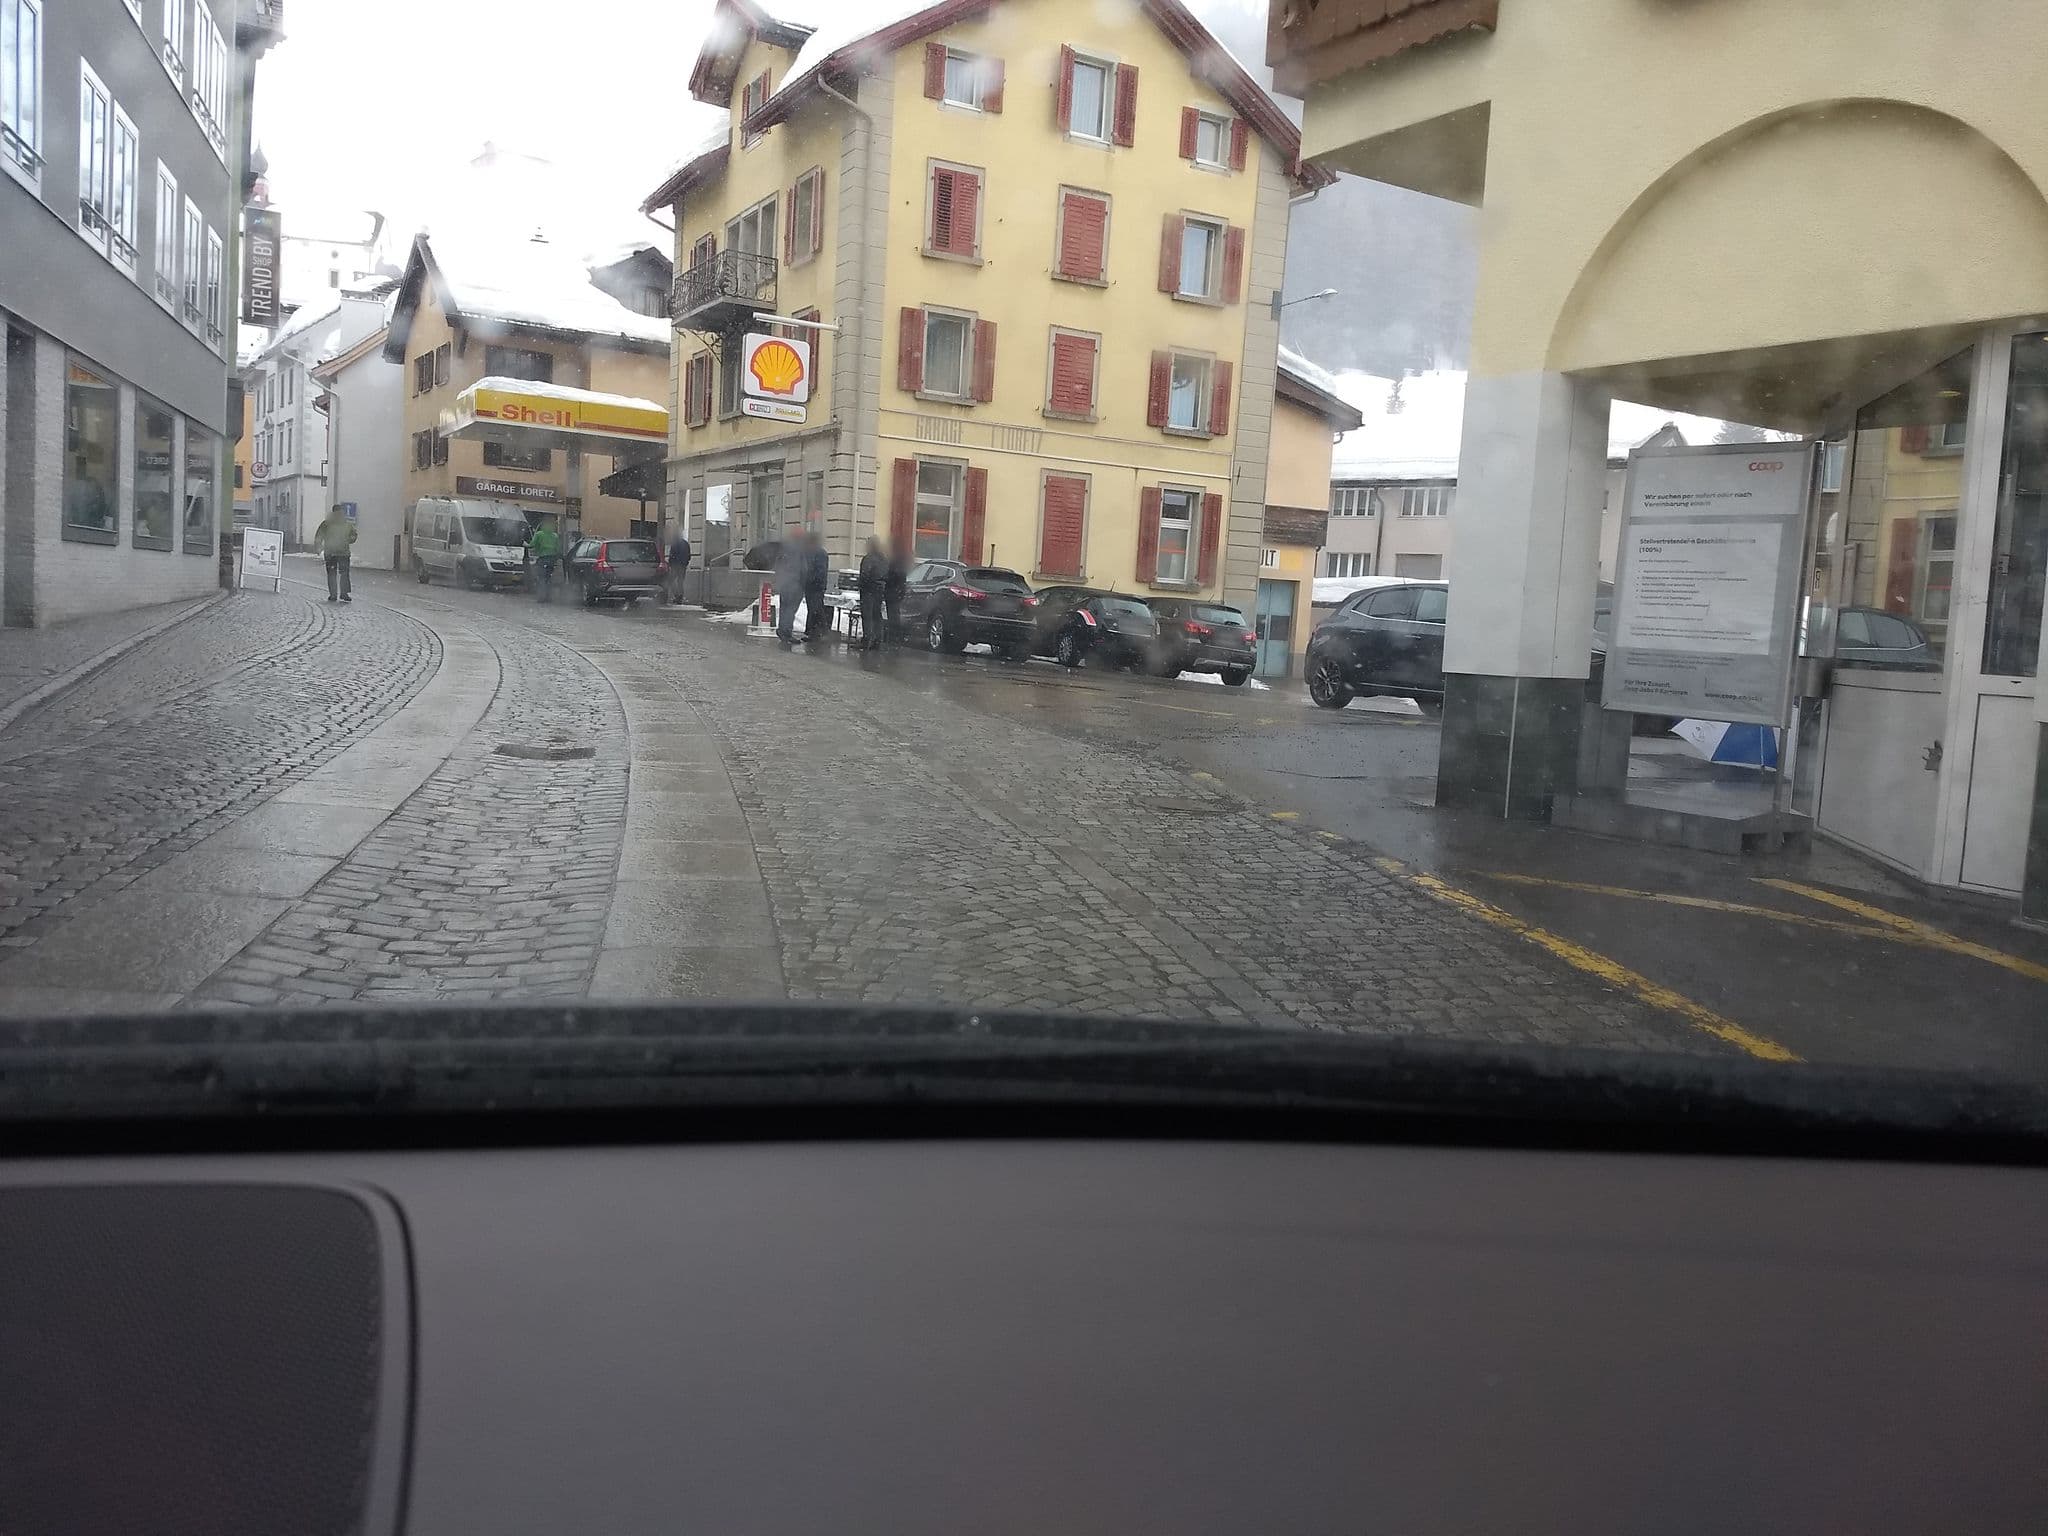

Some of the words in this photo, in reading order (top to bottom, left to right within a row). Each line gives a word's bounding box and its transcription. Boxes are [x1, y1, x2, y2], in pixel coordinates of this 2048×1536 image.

[252, 236, 273, 256] BY
[252, 266, 273, 318] TREND
[502, 404, 571, 427] Shell
[1749, 462, 1784, 472] coop
[476, 482, 515, 495] GARAGE
[520, 486, 554, 499] LORETZ
[1657, 492, 1681, 500] suchen
[1735, 490, 1753, 499] nach
